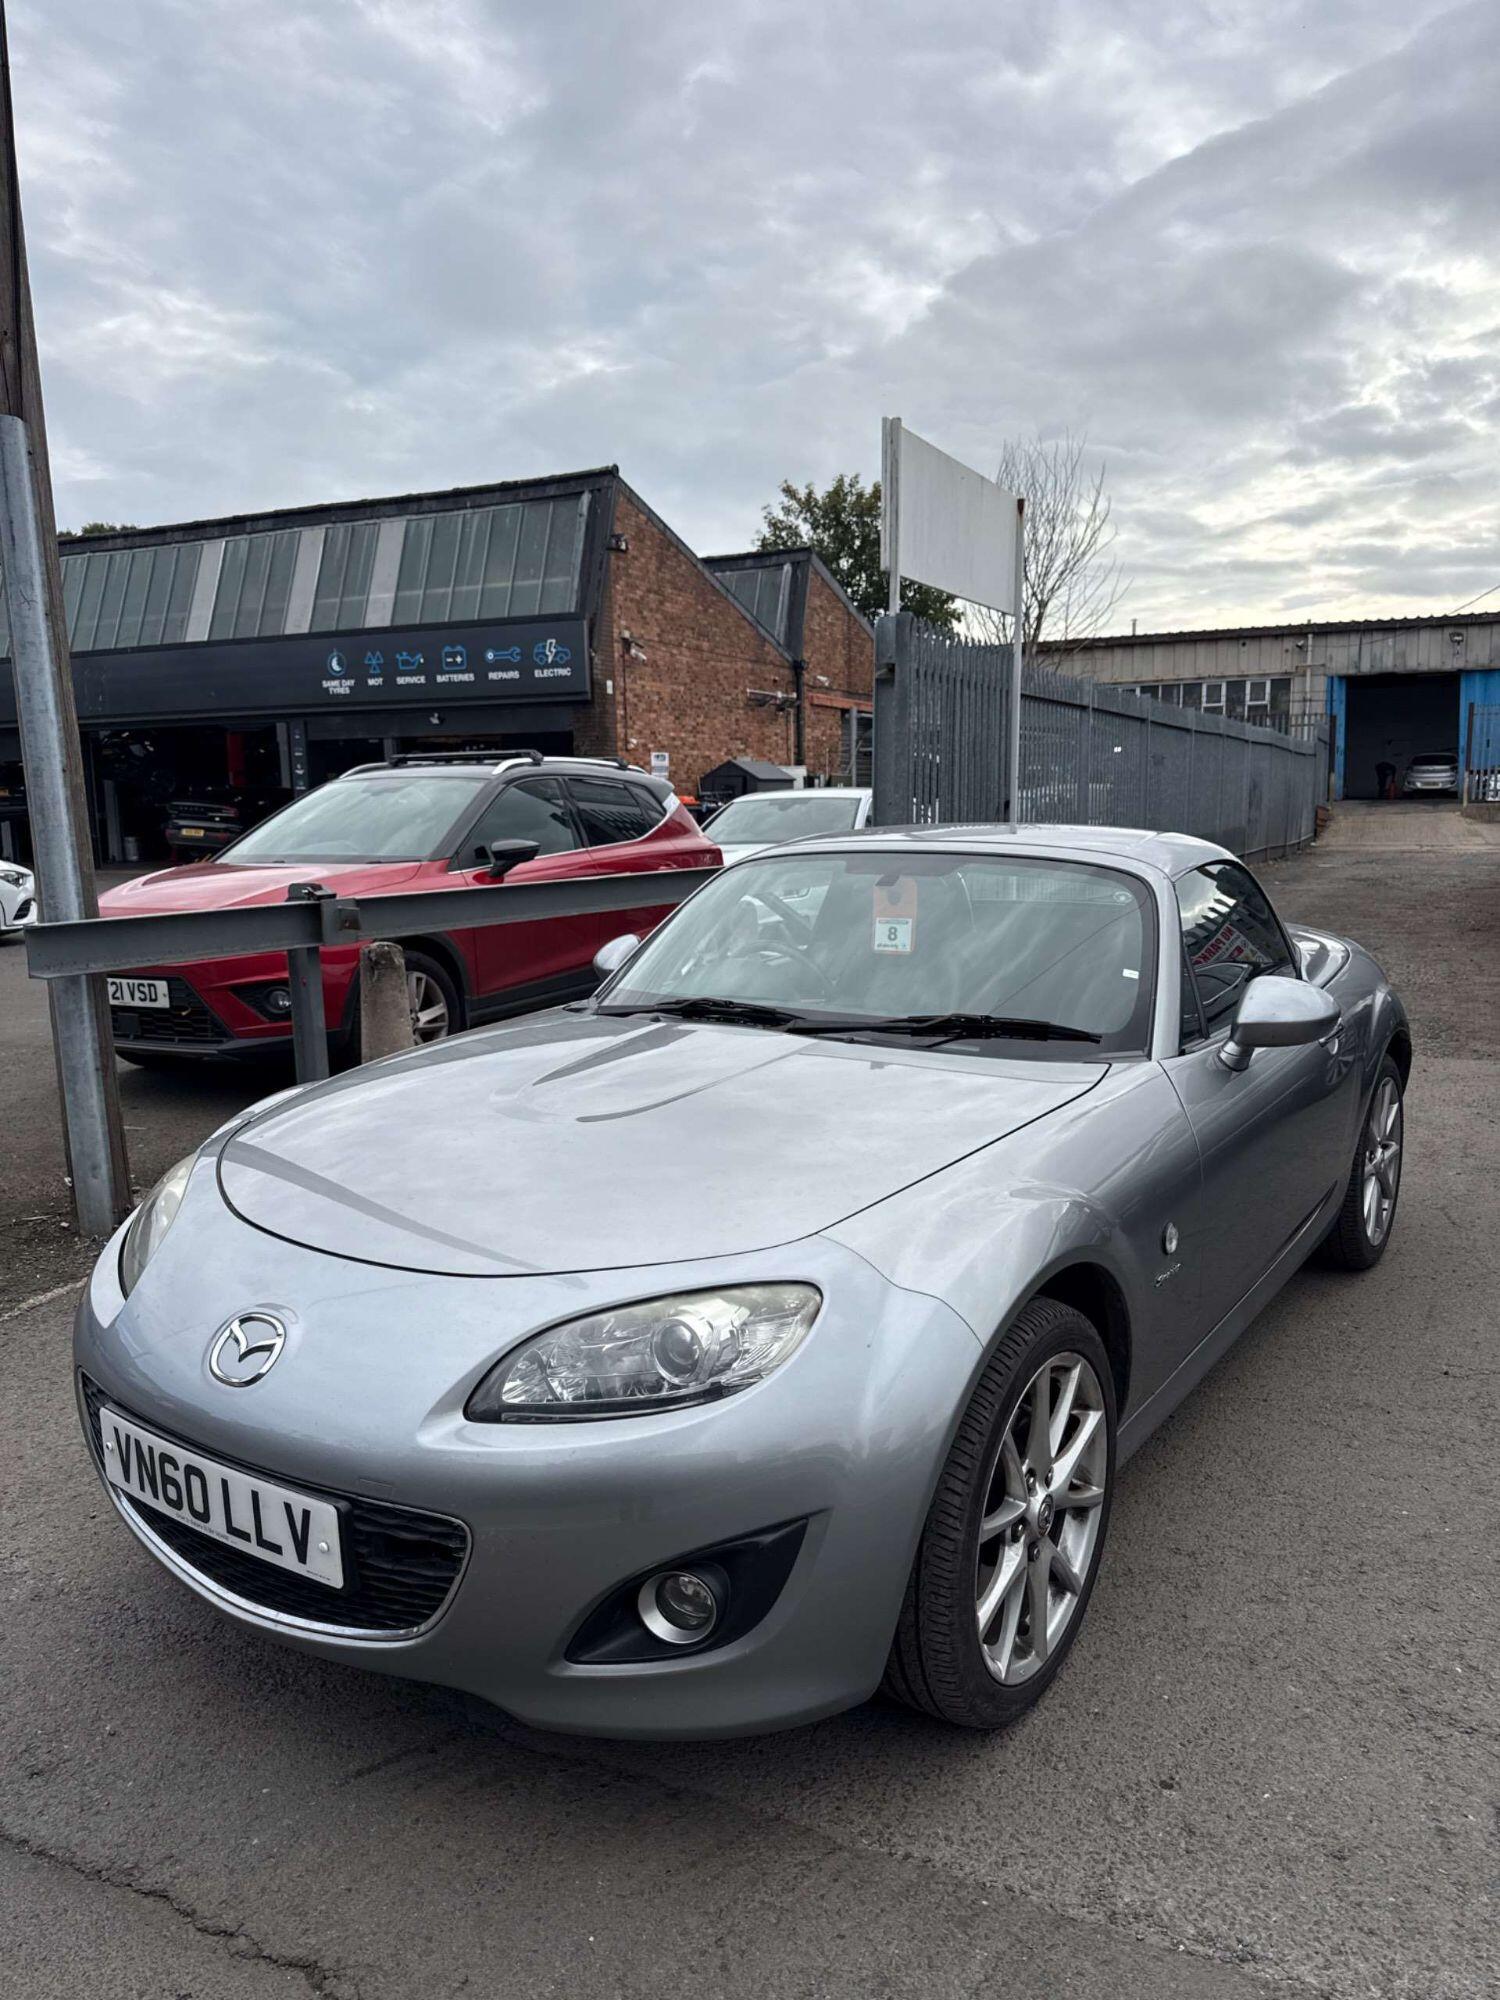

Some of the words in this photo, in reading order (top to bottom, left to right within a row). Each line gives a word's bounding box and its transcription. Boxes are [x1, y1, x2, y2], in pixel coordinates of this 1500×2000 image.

[488, 671, 520, 680] REPAIRS
[534, 668, 572, 678] ELECTRIC
[367, 678, 383, 687] MOT
[396, 676, 426, 685] SERVICE
[436, 673, 475, 683] BATTERIES
[322, 680, 340, 688] SAME
[341, 679, 355, 687] DAY
[328, 687, 350, 695] TYRES
[888, 926, 898, 941] 8
[107, 981, 124, 1001] 21
[126, 982, 158, 1002] VSD
[113, 1426, 211, 1524] VN60
[221, 1477, 311, 1565] LLV
